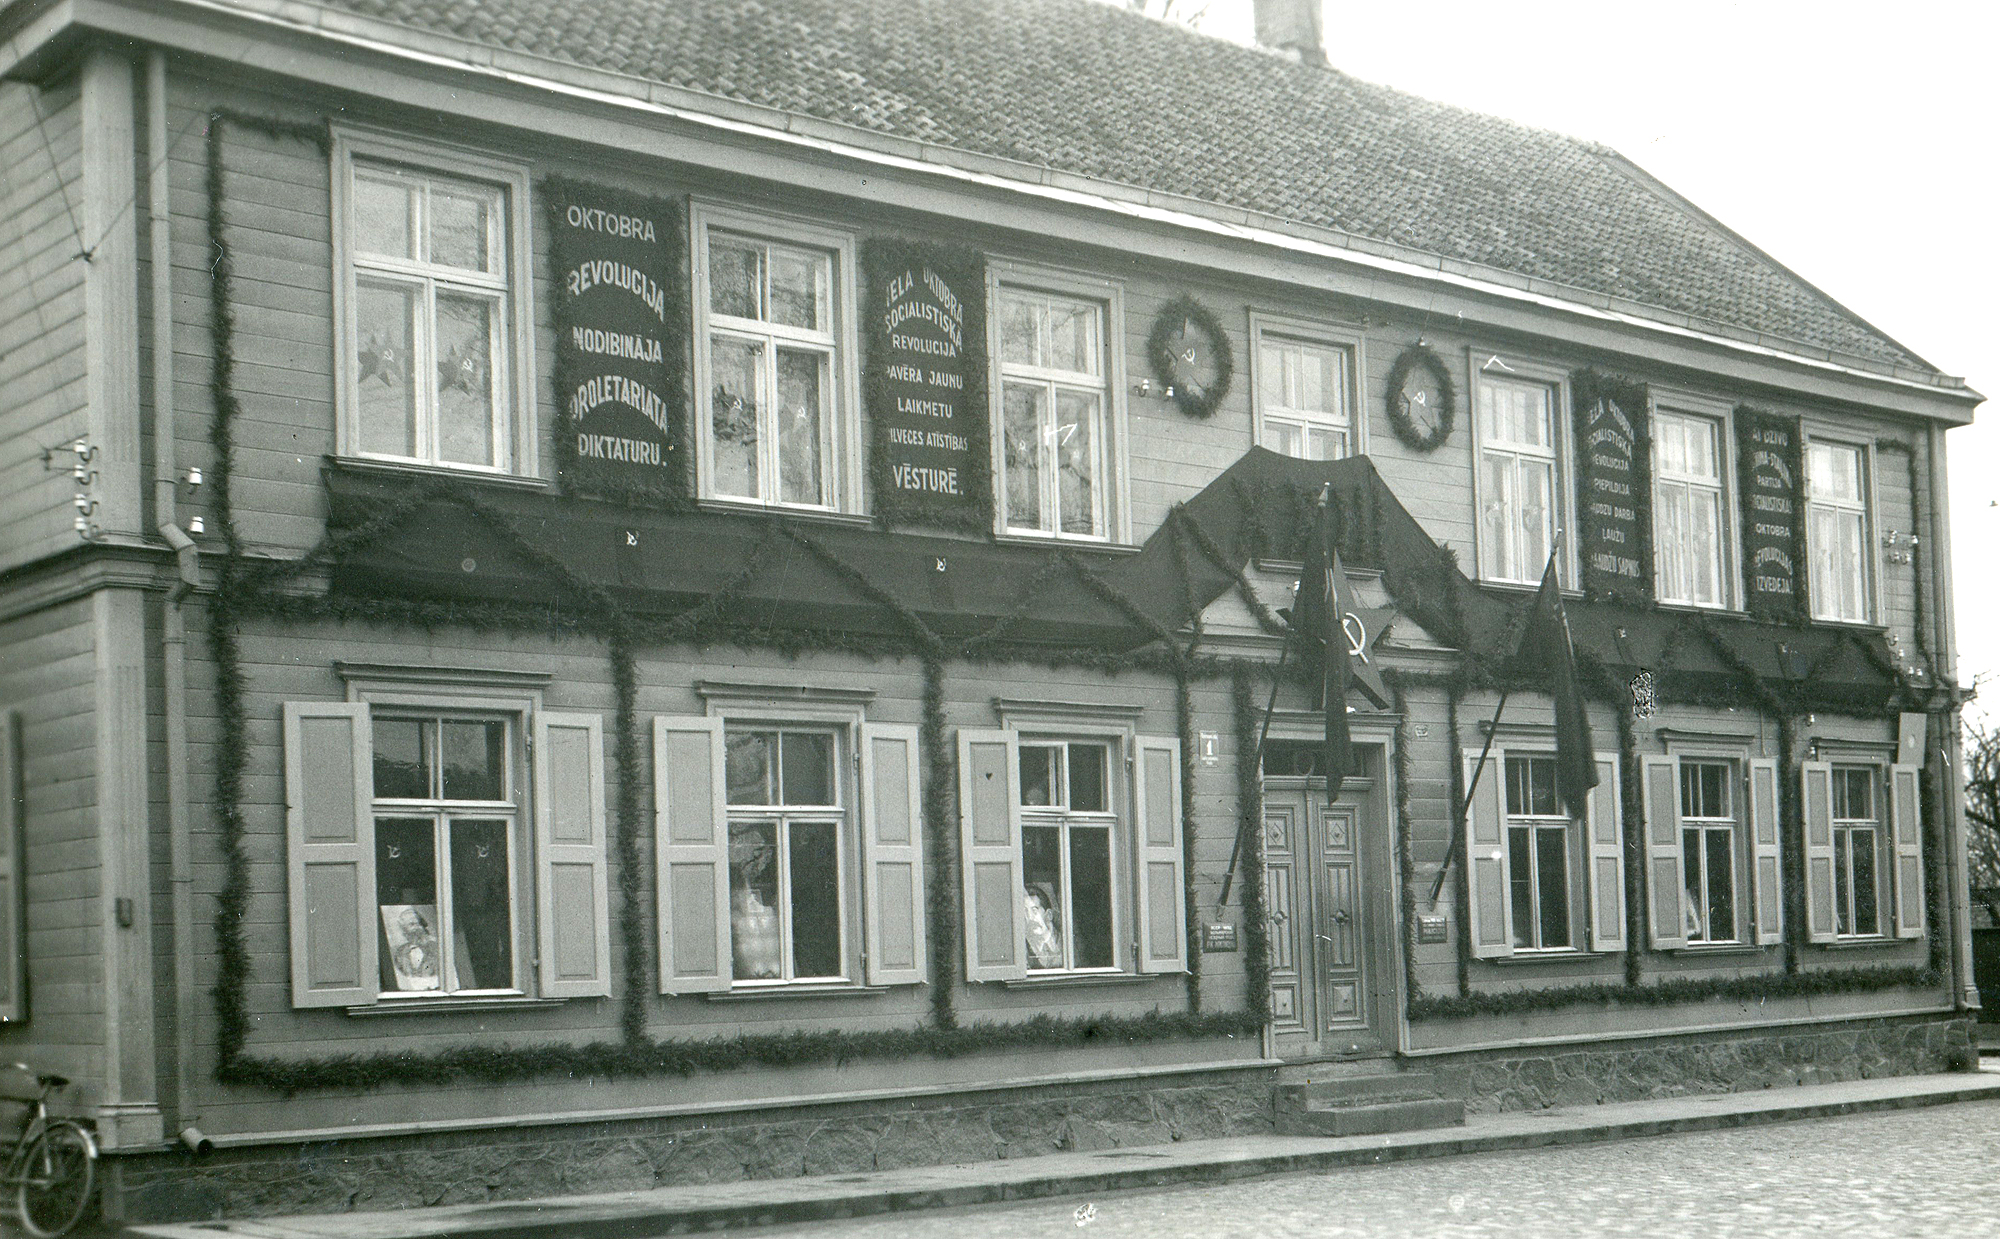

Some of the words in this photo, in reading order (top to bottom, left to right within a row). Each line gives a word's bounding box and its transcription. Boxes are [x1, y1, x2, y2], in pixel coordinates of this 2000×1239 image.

[567, 205, 656, 243] OKTOBRA
[567, 260, 665, 322] REVOLUCIJA
[573, 327, 663, 364] NODIBINĀJA
[892, 334, 956, 358] REVOLUCIJA
[887, 364, 923, 384] AVĒRA
[929, 371, 963, 390] JAUNU
[898, 397, 953, 418] LAIKMETU
[578, 433, 667, 467] DIKTATURU.
[892, 463, 964, 496] VĒSTURĒ.
[1755, 523, 1791, 538] OKTOBRA
[1206, 740, 1213, 756] 1
